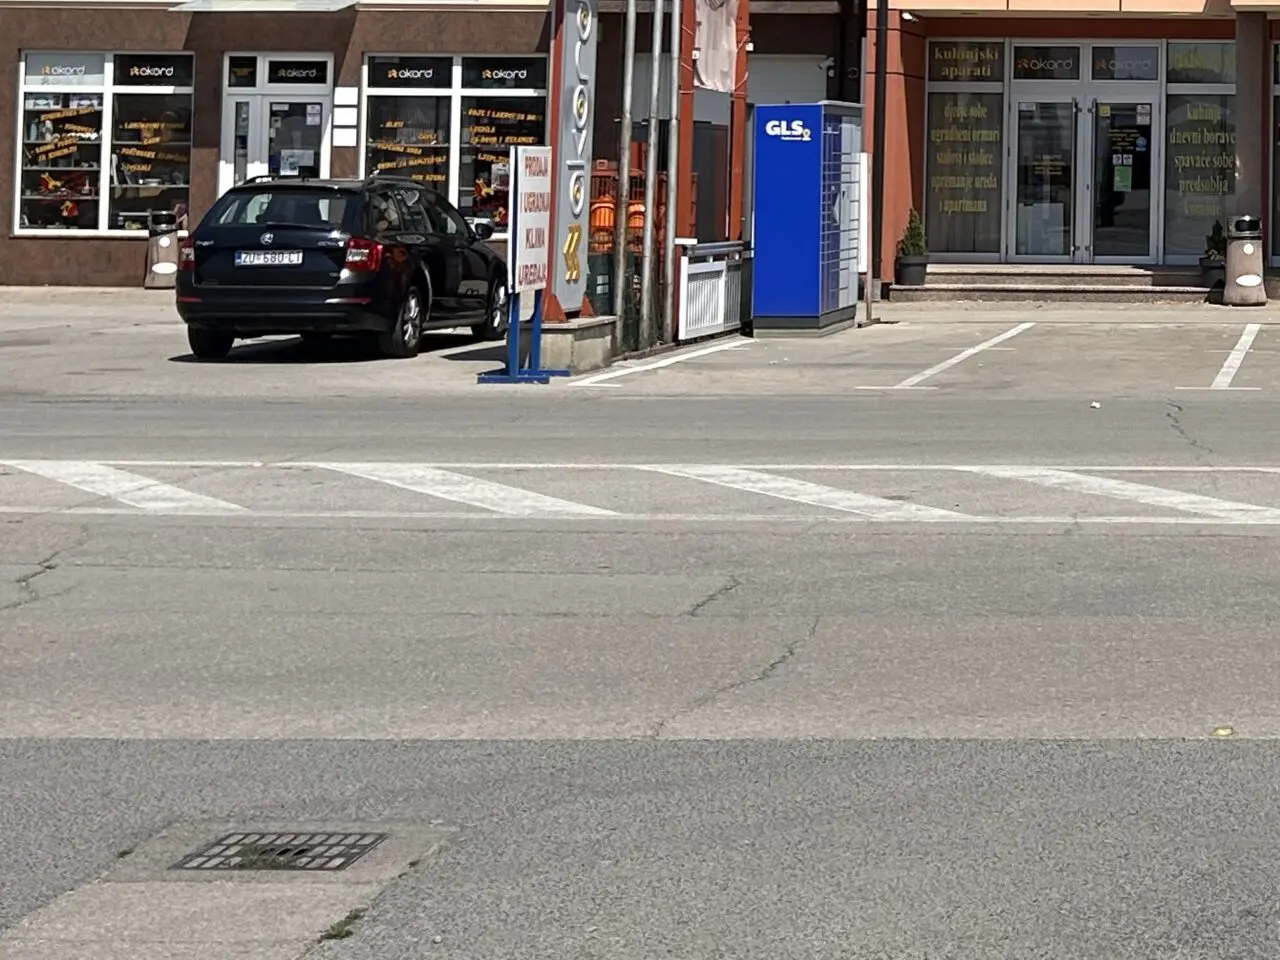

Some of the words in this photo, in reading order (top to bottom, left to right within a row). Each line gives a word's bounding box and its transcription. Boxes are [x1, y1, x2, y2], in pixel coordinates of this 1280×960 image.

[1030, 58, 1073, 70] akord
[51, 65, 86, 75] akord
[139, 66, 174, 77] akord
[286, 68, 317, 77] akord
[398, 68, 433, 79] akord
[492, 68, 528, 79] akord
[941, 64, 991, 79] aparati
[765, 120, 804, 136] GLS
[1170, 128, 1202, 144] dnevni
[1174, 150, 1211, 173] spavaće
[1212, 152, 1234, 168] sobe
[1178, 175, 1229, 196] predsoblja
[242, 252, 255, 263] ZU
